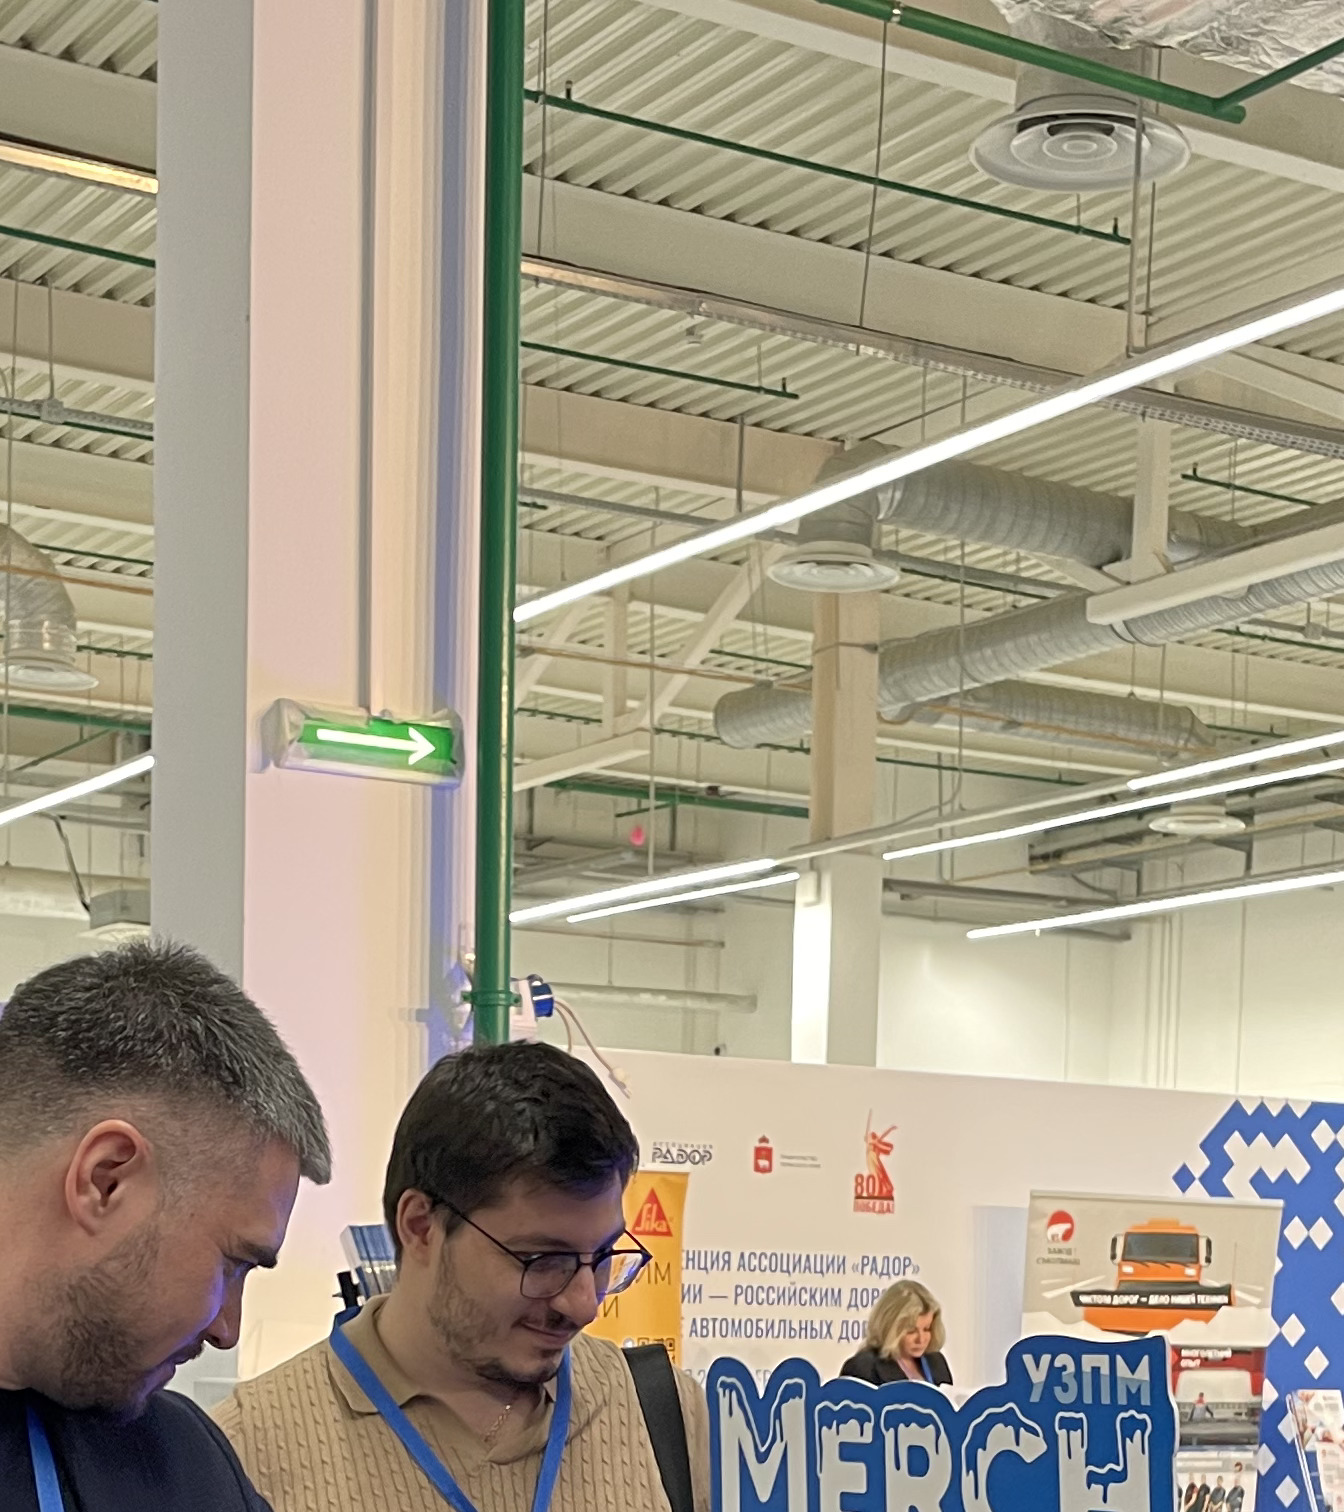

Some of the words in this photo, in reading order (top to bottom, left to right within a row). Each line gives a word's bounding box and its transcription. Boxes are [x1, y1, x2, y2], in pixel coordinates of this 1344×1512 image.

[854, 1173, 876, 1197] 80
[634, 1203, 669, 1233] Sika
[737, 1250, 846, 1277] АССОЦИАЦИИ
[851, 1254, 920, 1279] «РАДОР»
[733, 1281, 842, 1308] РОССИЙСКИМ
[846, 1287, 888, 1312] ДОР
[689, 1316, 834, 1341] АВТОМОБИЛЬНЫХ
[1021, 1352, 1152, 1406] УЗПМ
